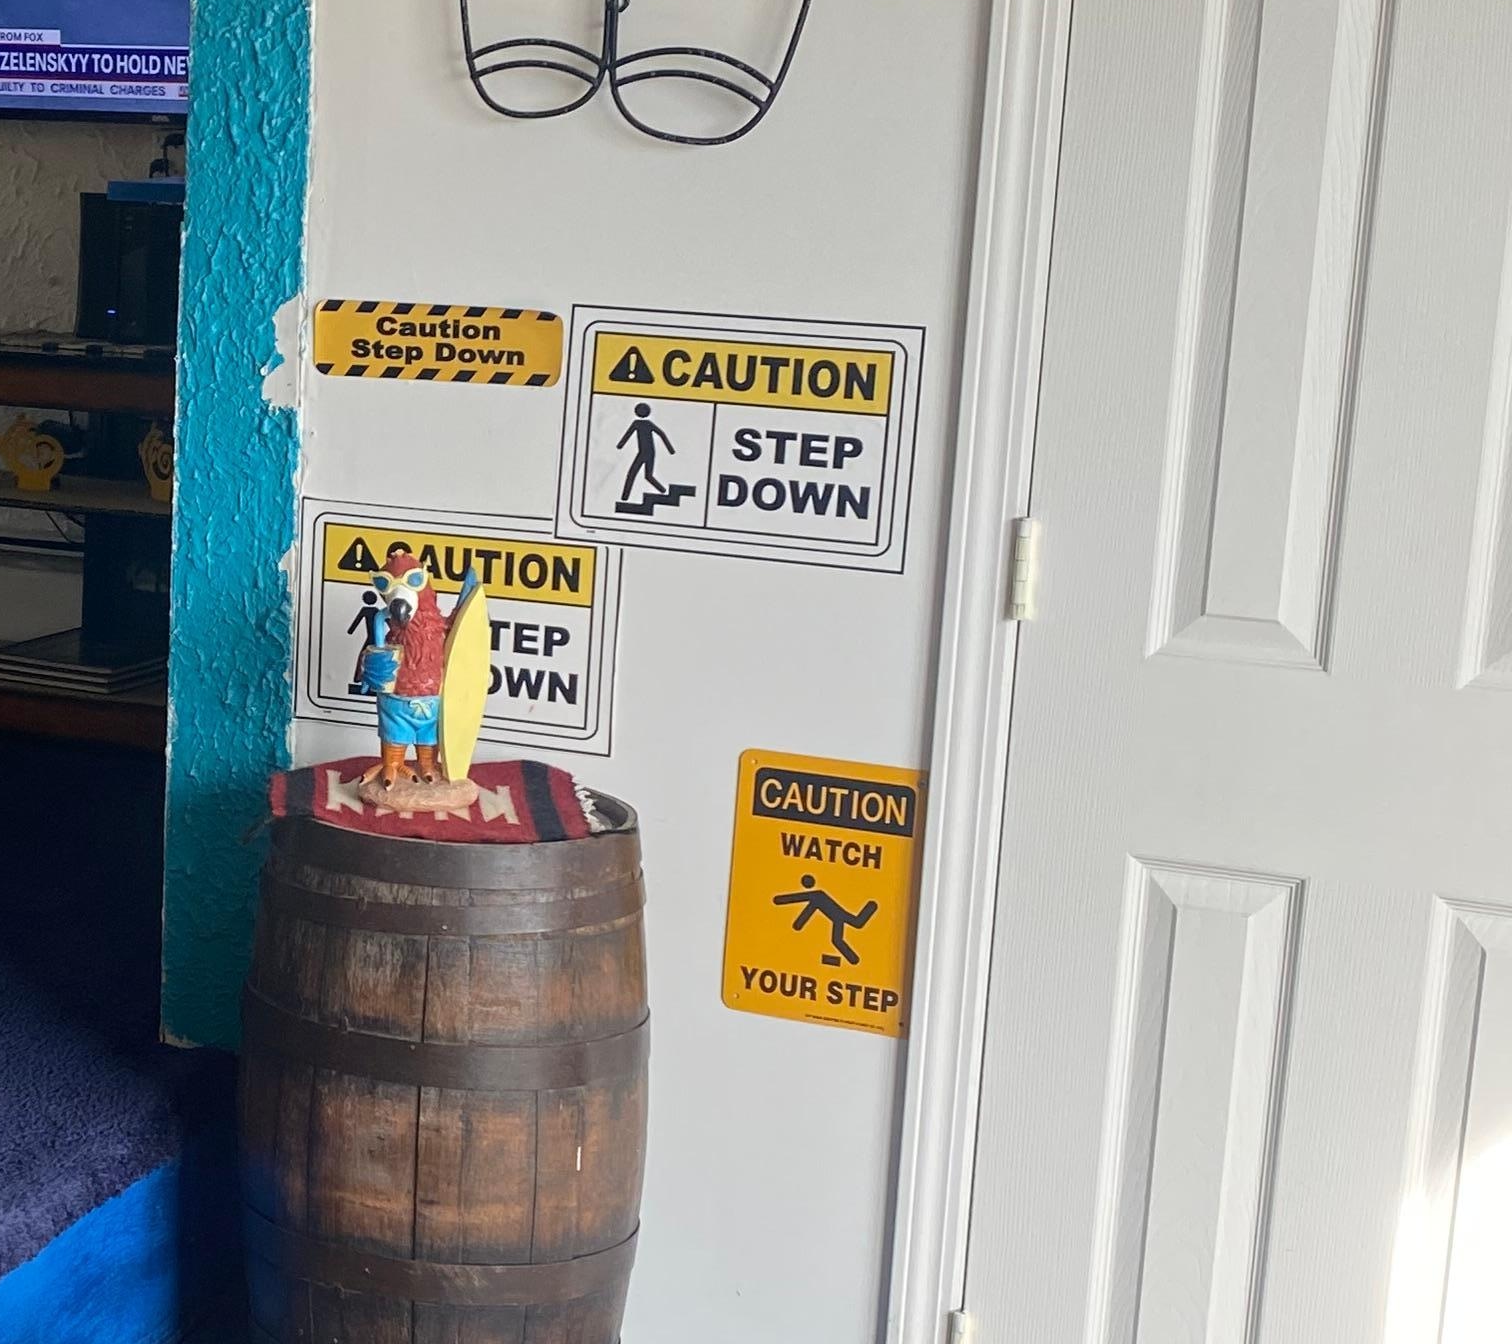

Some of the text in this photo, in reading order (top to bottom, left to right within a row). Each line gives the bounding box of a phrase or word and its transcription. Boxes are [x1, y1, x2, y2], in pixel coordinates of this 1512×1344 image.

[23, 32, 44, 43] FOX
[0, 51, 89, 73] ZELENSKYY
[91, 53, 114, 74] TO
[116, 54, 161, 75] HOLD
[164, 55, 190, 76] NE
[31, 82, 45, 93] TO
[50, 83, 105, 95] CRIMINAL
[109, 84, 166, 97] CHARGES
[375, 316, 501, 341] Caution
[350, 338, 525, 366] Step Down
[662, 349, 877, 401] CAUTION
[732, 428, 864, 469] STEP
[717, 474, 871, 520] DOWN
[489, 619, 571, 657] TEP
[760, 778, 908, 827] CAUTION
[780, 831, 883, 870] WATCH
[739, 965, 899, 1013] YOUR STEP
